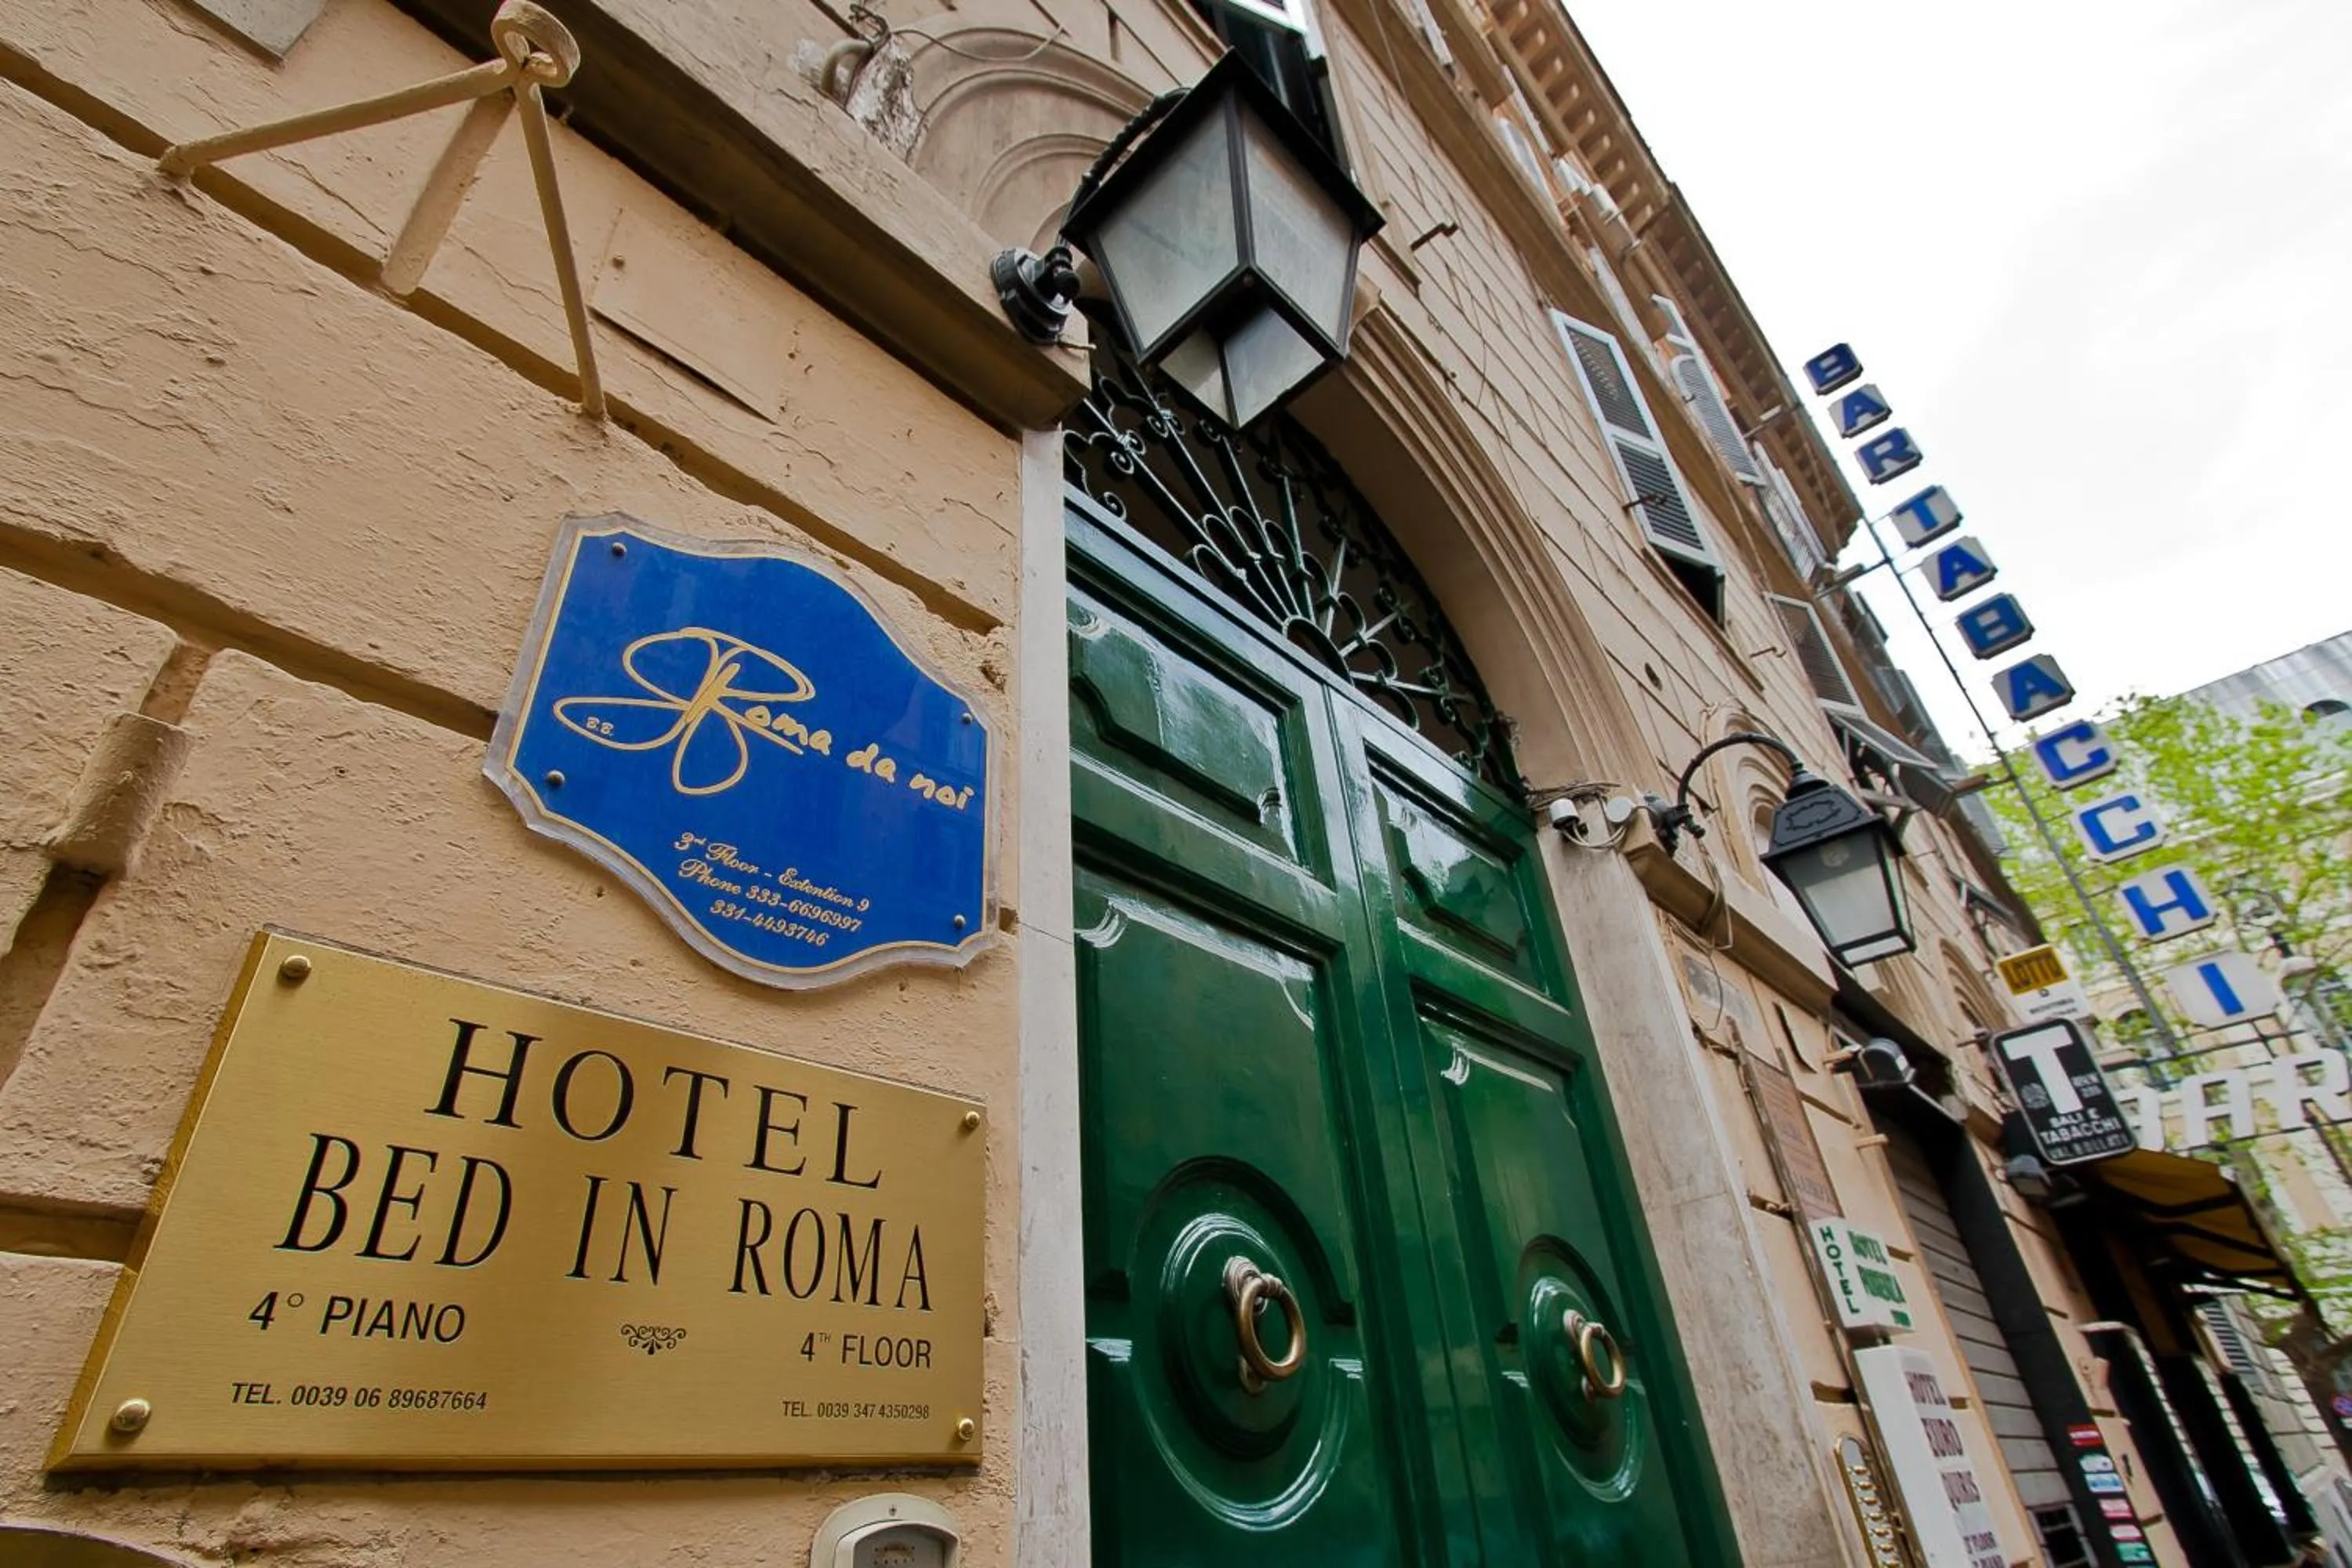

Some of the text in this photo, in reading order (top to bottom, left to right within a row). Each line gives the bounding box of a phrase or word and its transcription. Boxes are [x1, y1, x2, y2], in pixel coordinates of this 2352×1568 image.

[1806, 344, 2245, 1017] BAR TABACCHI
[847, 743, 895, 782] da
[909, 773, 975, 809] noi
[678, 858, 862, 932] Phone 333-6696997
[706, 843, 759, 875] Floor
[857, 898, 869, 912] 9
[710, 900, 829, 947] 331-4493746
[2001, 1024, 2084, 1115] T
[424, 1018, 883, 1189] HOTEL
[2039, 1116, 2122, 1145] TABACCHI
[274, 1132, 933, 1312] BED IN ROMA
[1819, 1225, 1860, 1315] HOTEL
[319, 1294, 465, 1343] PIANO
[841, 1334, 931, 1368] FLOOR
[231, 1382, 488, 1410] TEL. 0039 06 89687664
[782, 1400, 812, 1417] TEL.
[818, 1402, 849, 1418] 0039
